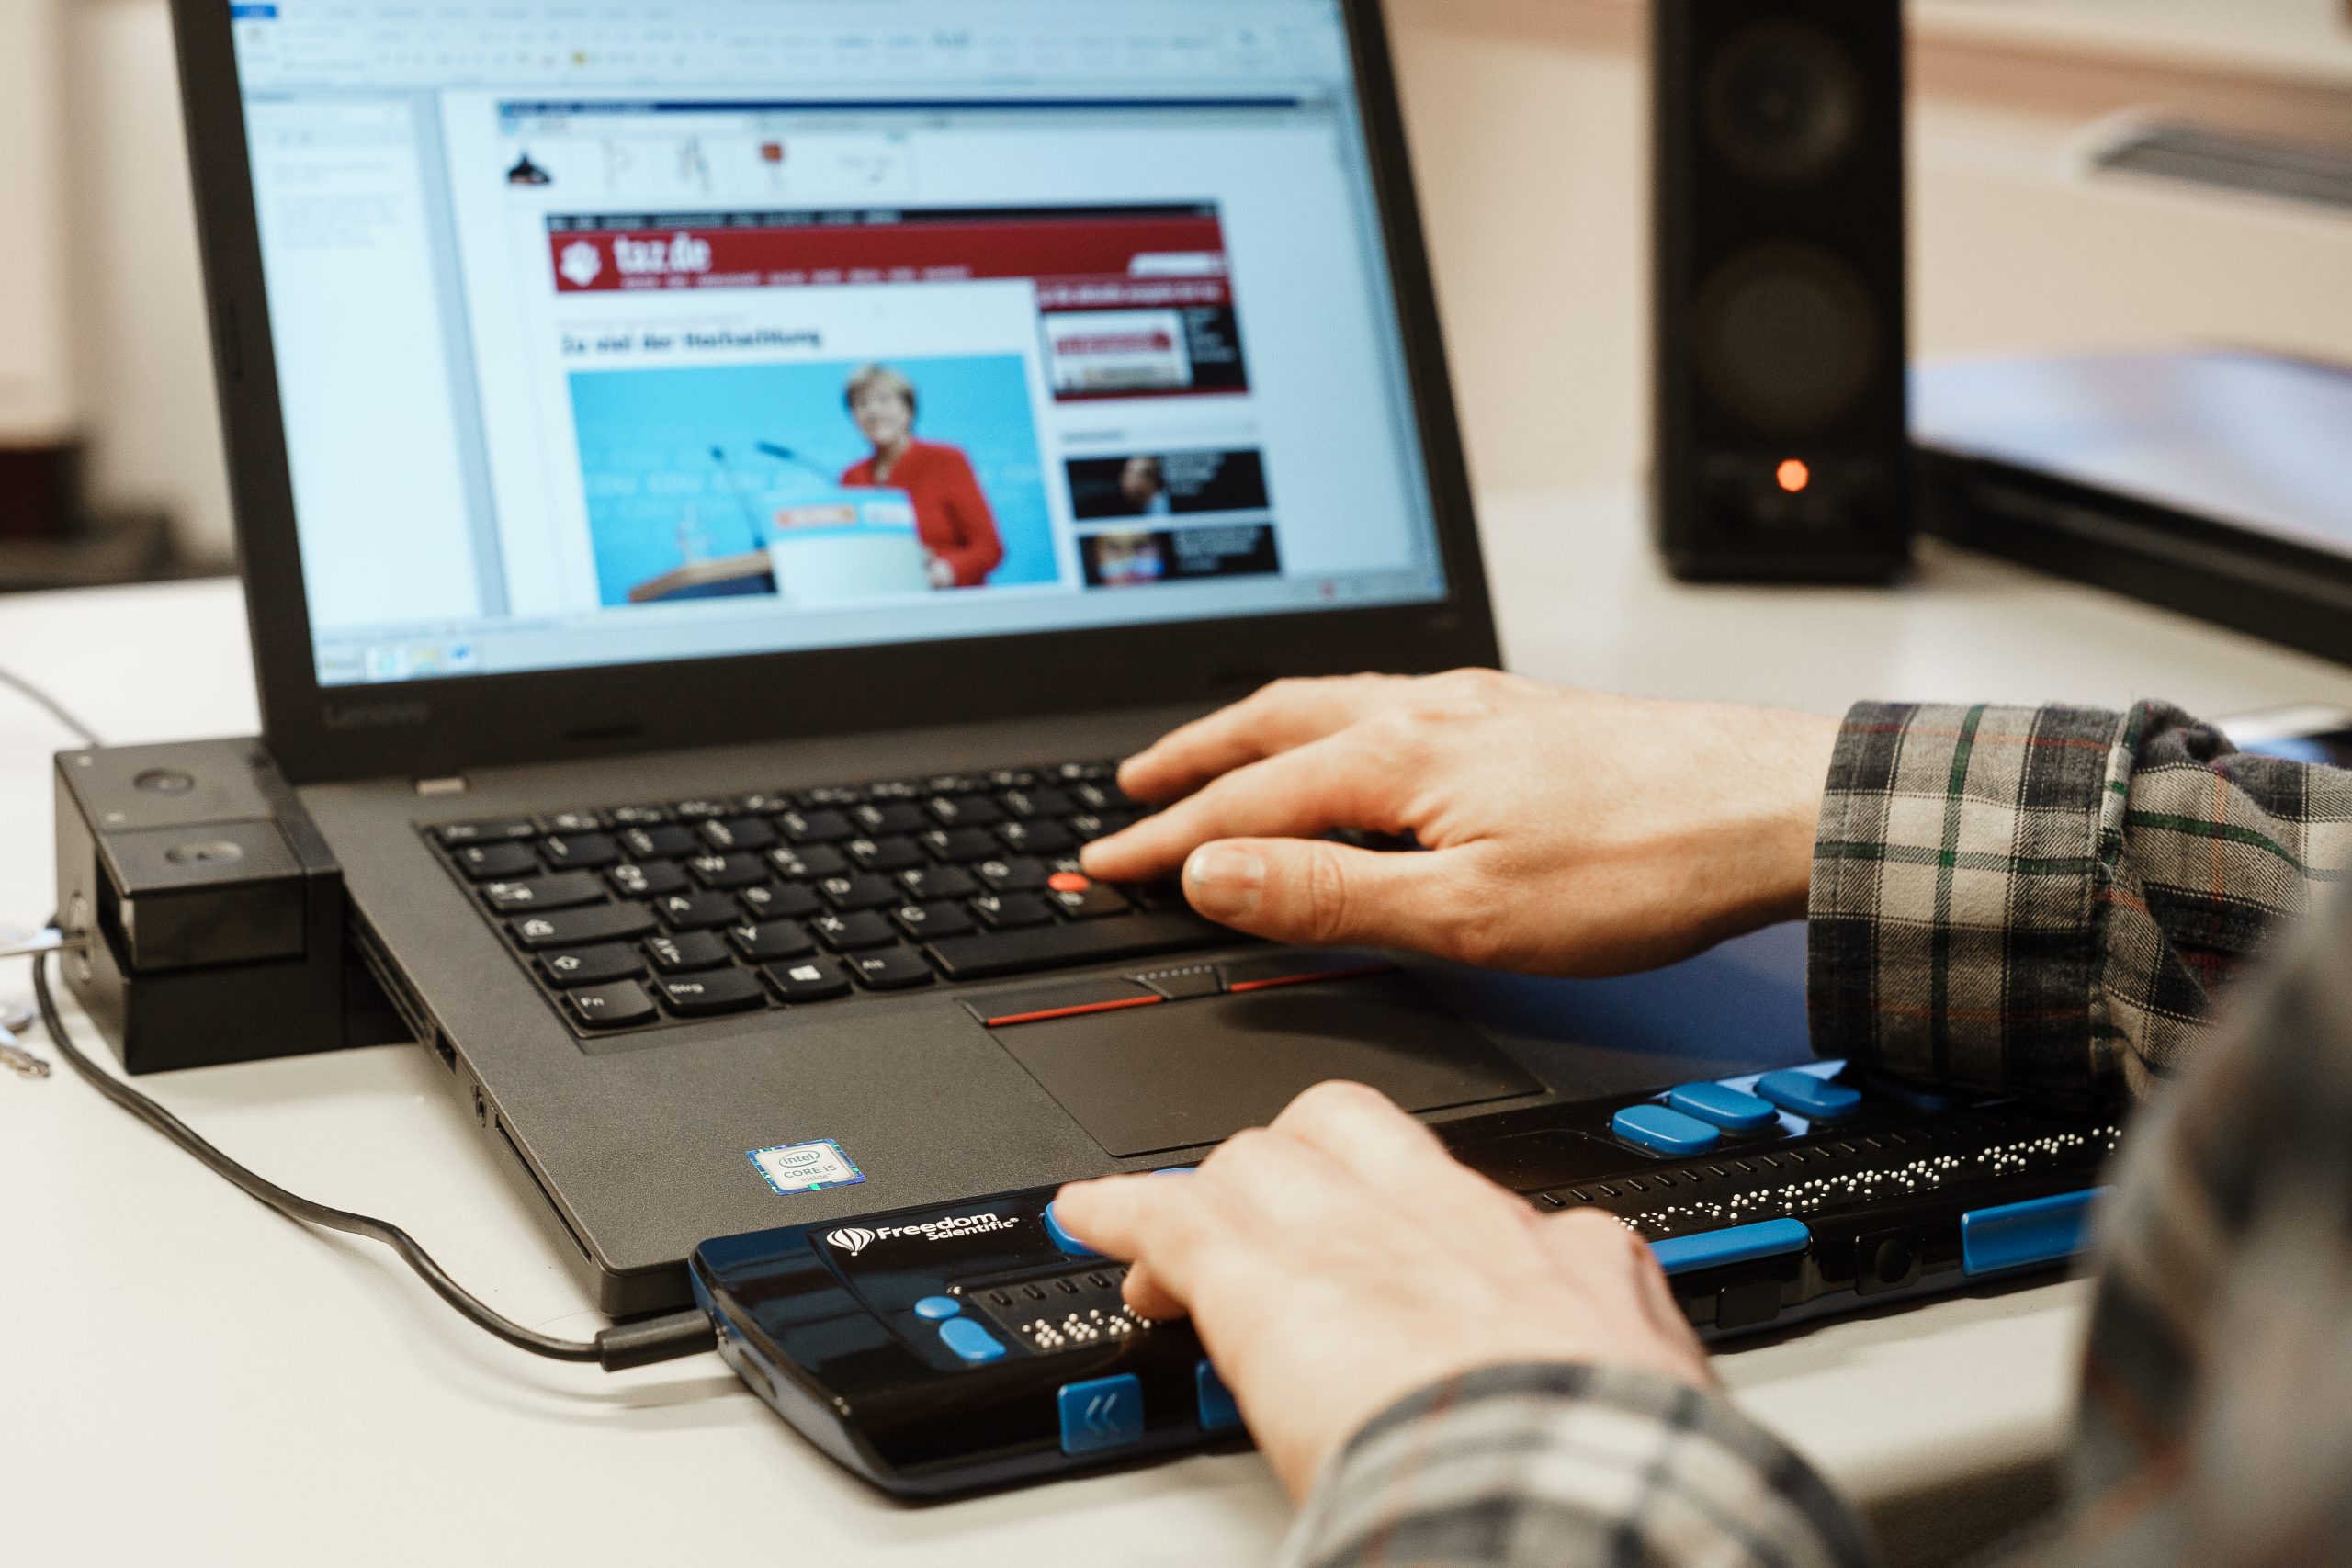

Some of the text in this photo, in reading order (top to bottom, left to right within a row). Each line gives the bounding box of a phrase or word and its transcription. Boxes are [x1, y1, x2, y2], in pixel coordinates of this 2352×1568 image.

[613, 232, 713, 274] taz.de
[580, 997, 605, 1008] Fn
[784, 1167, 822, 1179] CORE
[876, 1213, 998, 1240] Freedom
